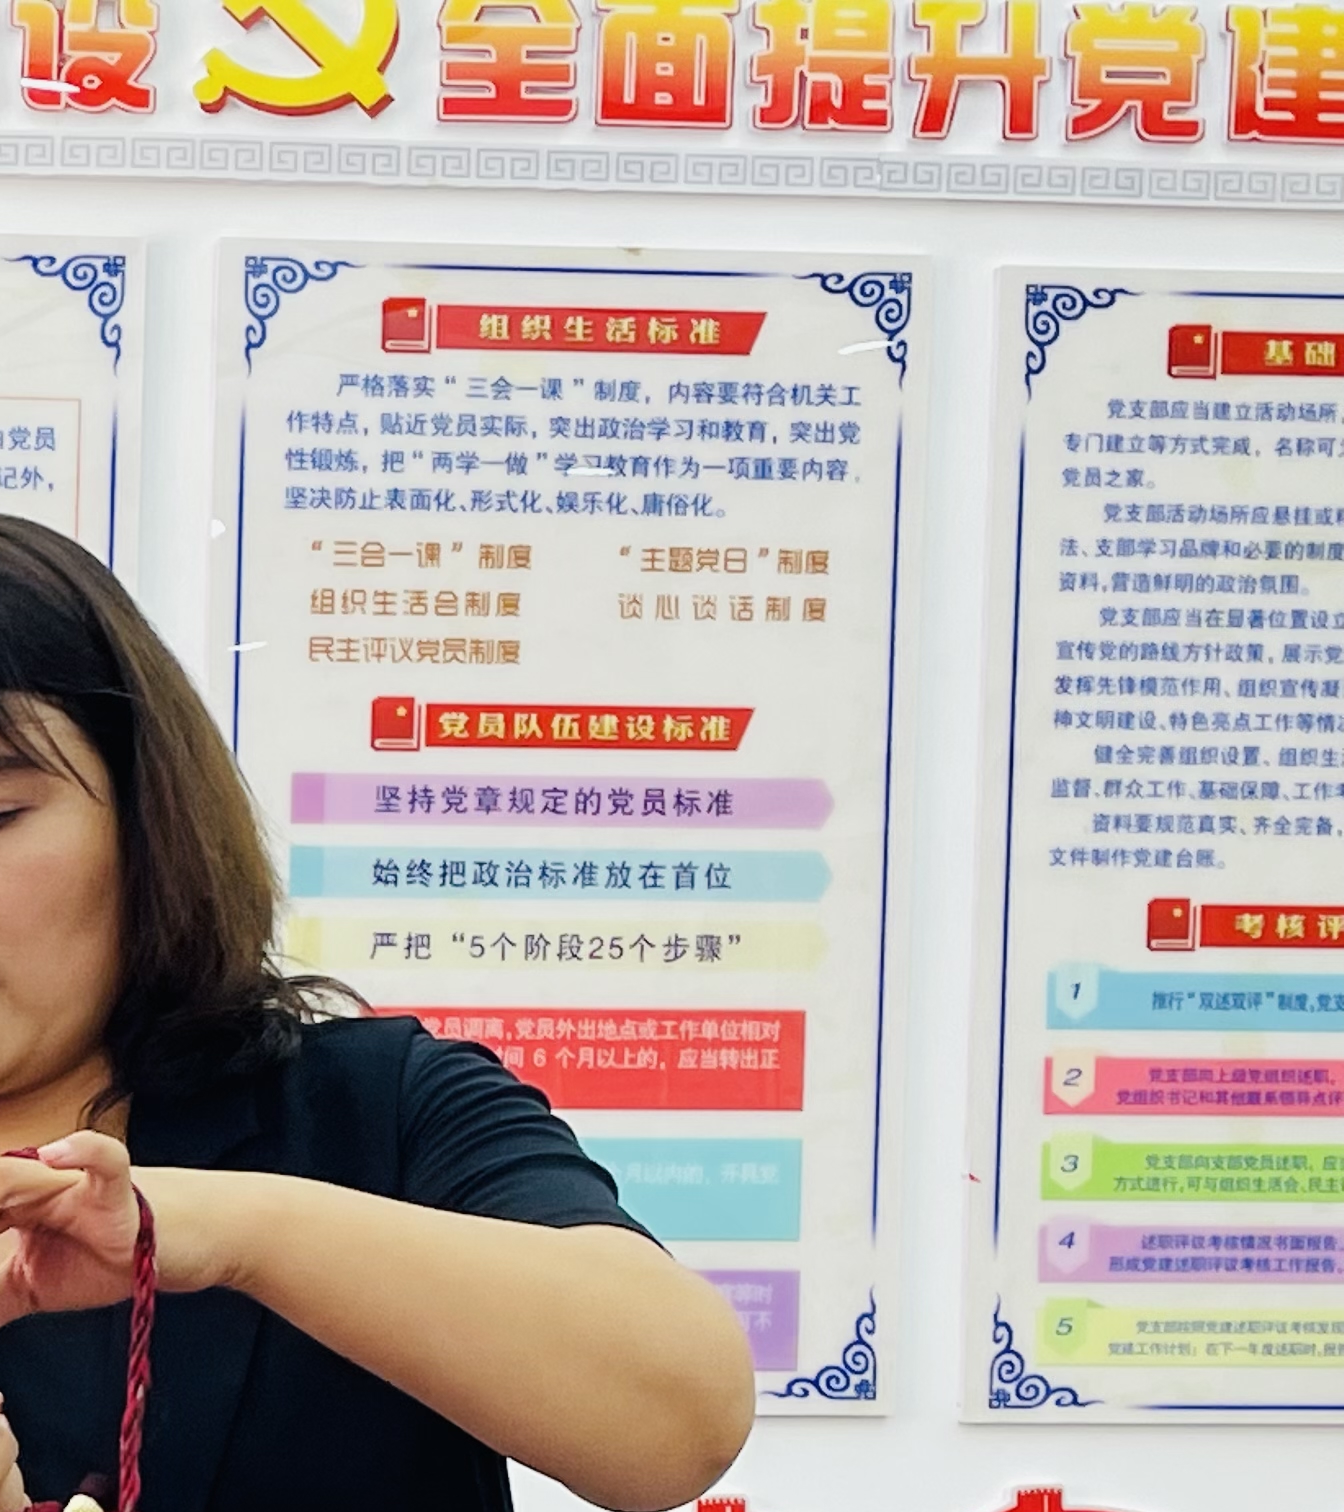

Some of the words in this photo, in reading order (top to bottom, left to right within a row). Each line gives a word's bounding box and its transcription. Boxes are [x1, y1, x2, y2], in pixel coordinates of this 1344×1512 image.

[479, 313, 722, 346] 组织生活标准
[1264, 339, 1336, 368] 基础
[1061, 467, 1156, 490] 党员之家。
[617, 592, 827, 623] 谈心谈话制度
[308, 635, 522, 667] 民主评议党员制度
[438, 711, 732, 743] 党员队伍建设标准
[1093, 744, 1344, 768] 健全完善组织设置、组织生
[374, 784, 735, 818] 坚持党章规定的党员标准
[371, 857, 733, 891] 始终把政治标准放在首位
[1069, 981, 1082, 1000] 1
[1063, 1067, 1083, 1087] 2
[1060, 1154, 1080, 1173] 3
[1058, 1231, 1077, 1249] 4
[1055, 1317, 1074, 1336] 5
